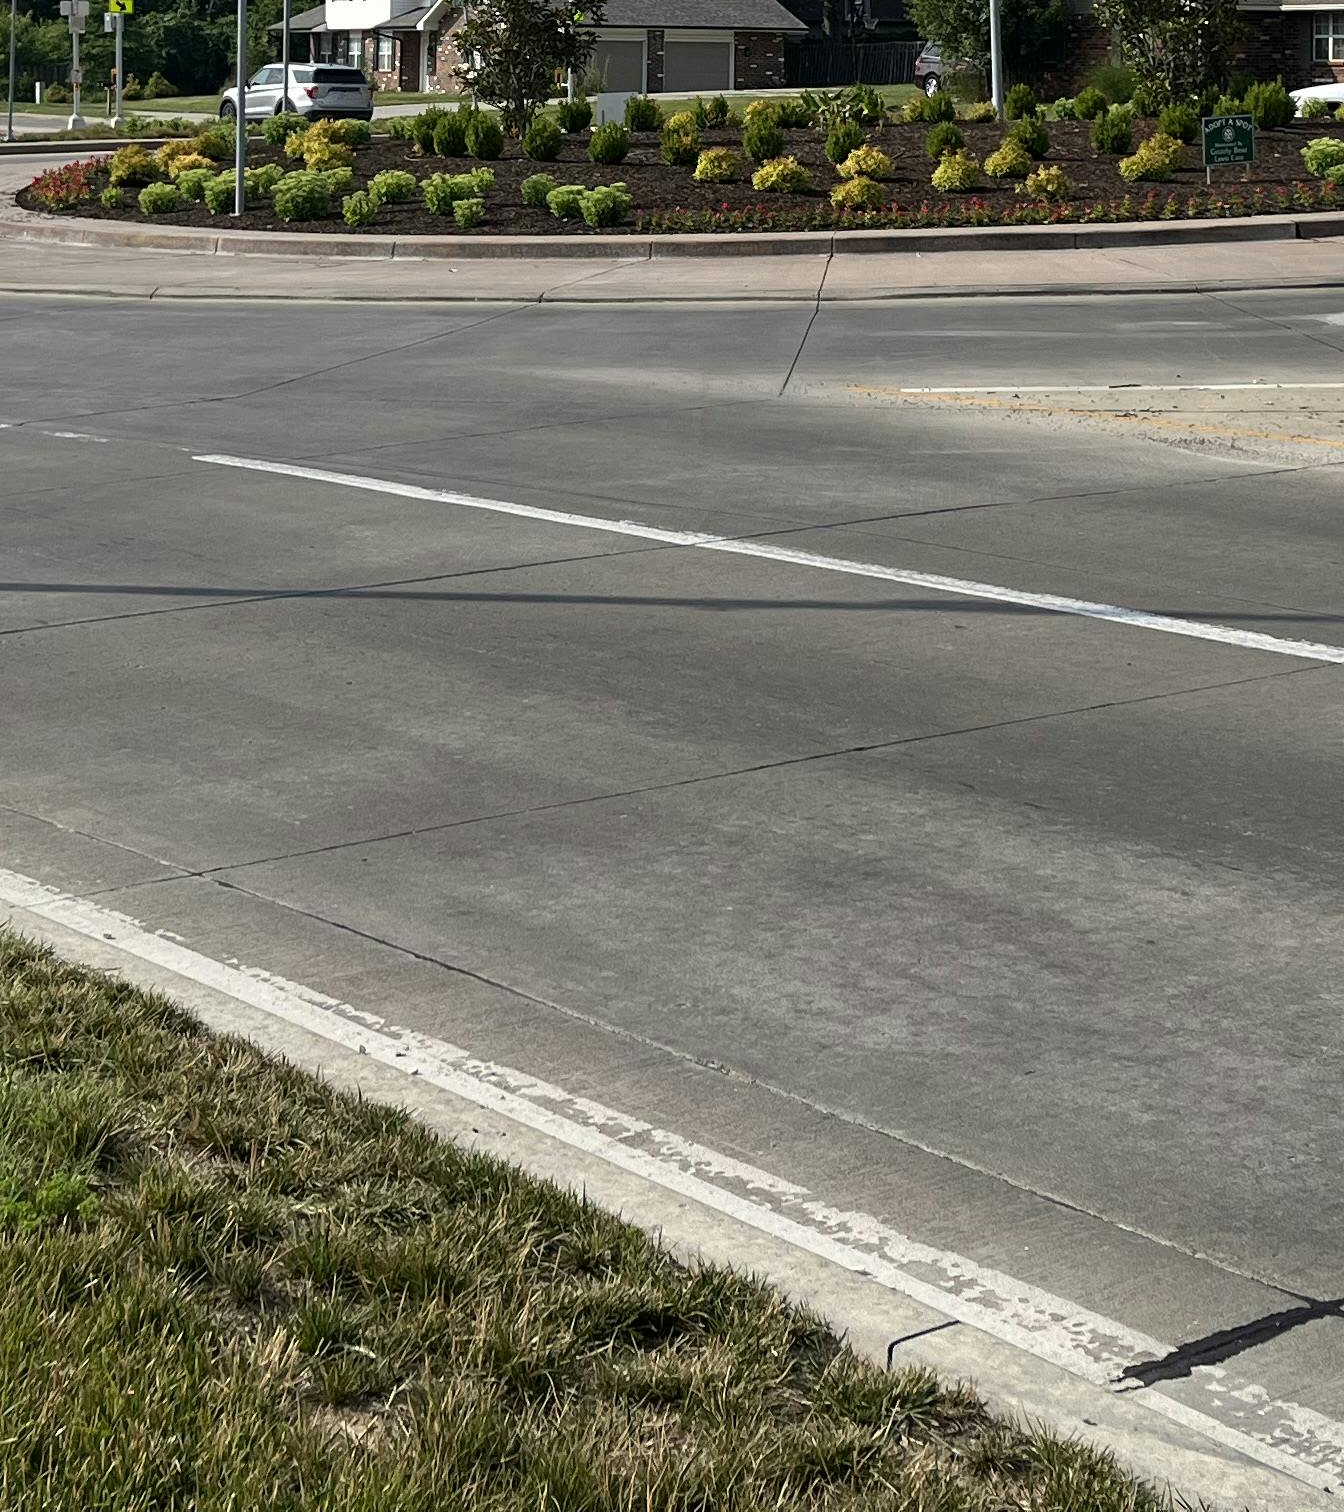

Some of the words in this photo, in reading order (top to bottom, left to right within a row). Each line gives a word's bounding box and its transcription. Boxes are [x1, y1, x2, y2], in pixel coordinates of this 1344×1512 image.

[1205, 118, 1226, 133] ADOPT
[1227, 118, 1234, 126] A
[1235, 118, 1253, 132] SPOT
